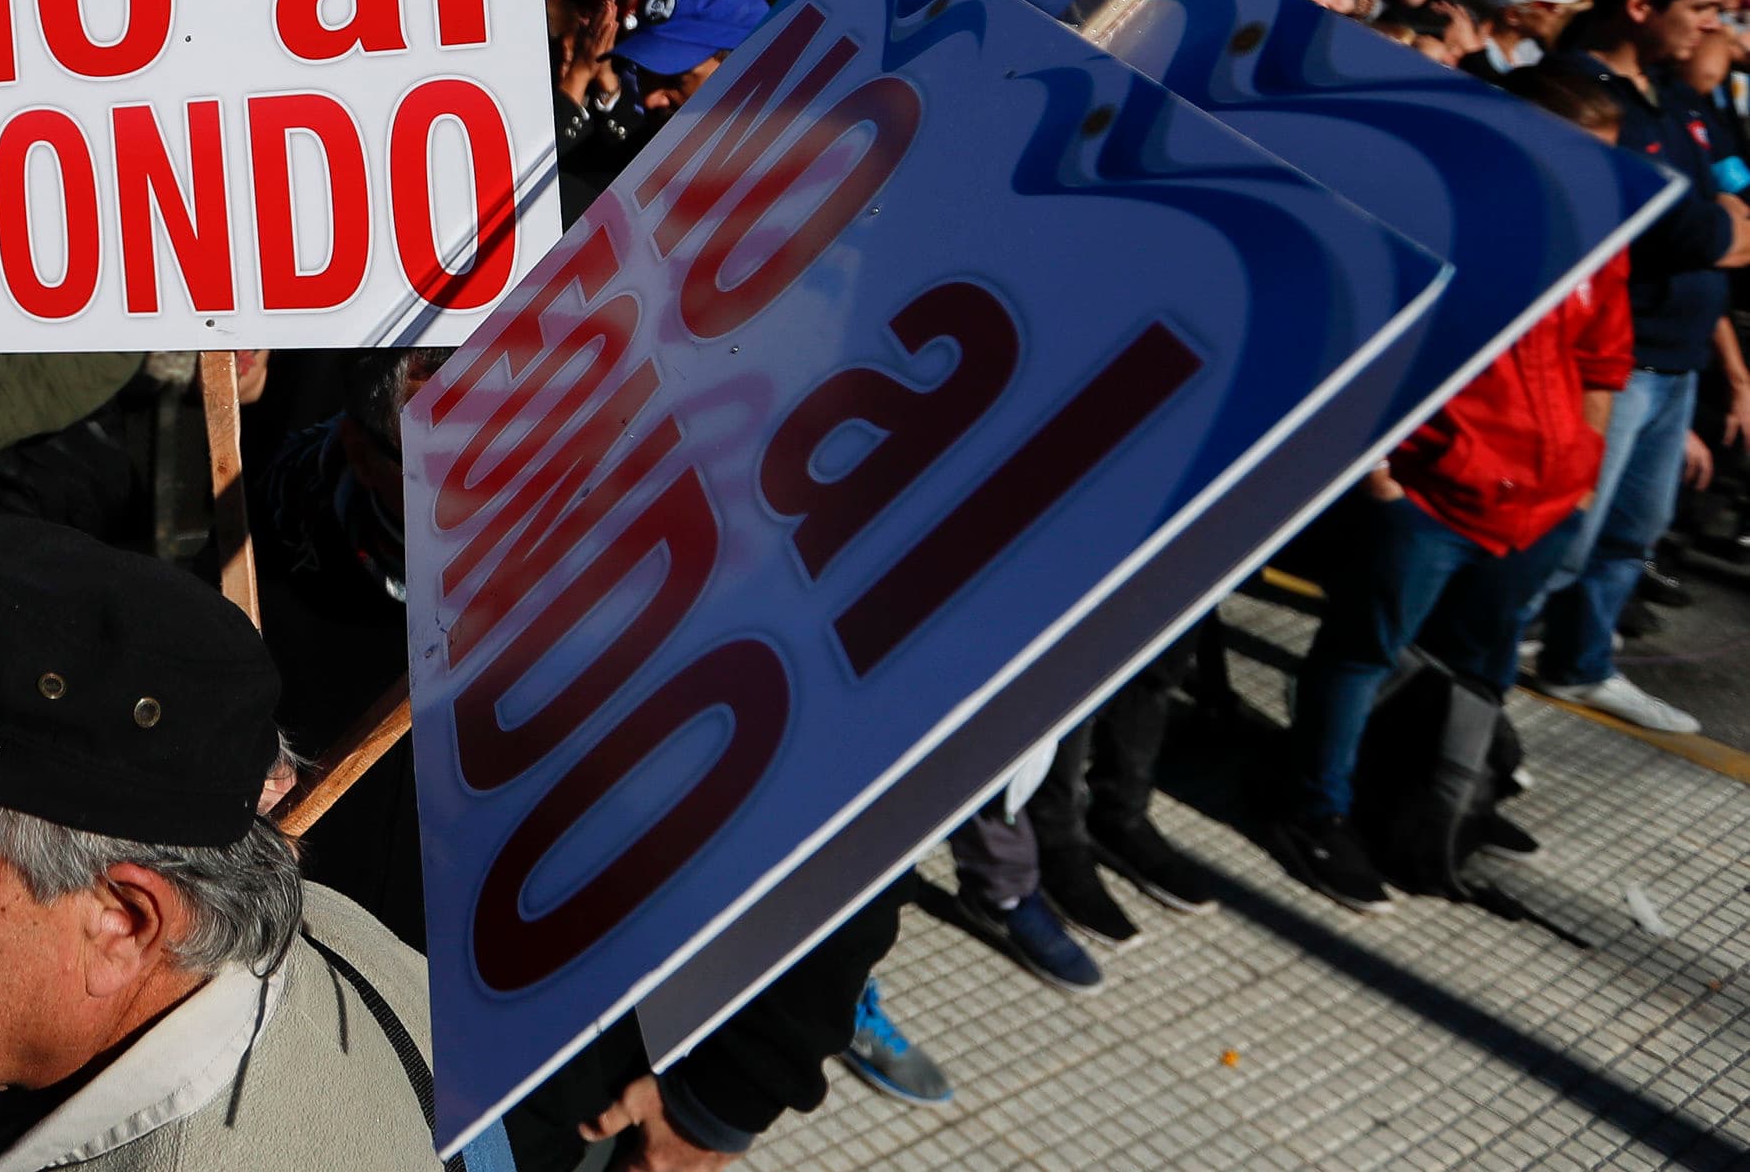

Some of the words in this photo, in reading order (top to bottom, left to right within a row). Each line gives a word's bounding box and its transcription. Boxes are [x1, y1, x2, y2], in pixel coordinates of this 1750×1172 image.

[633, 2, 921, 339] NO
[431, 225, 791, 992] FONDO
[760, 281, 1205, 679] al
